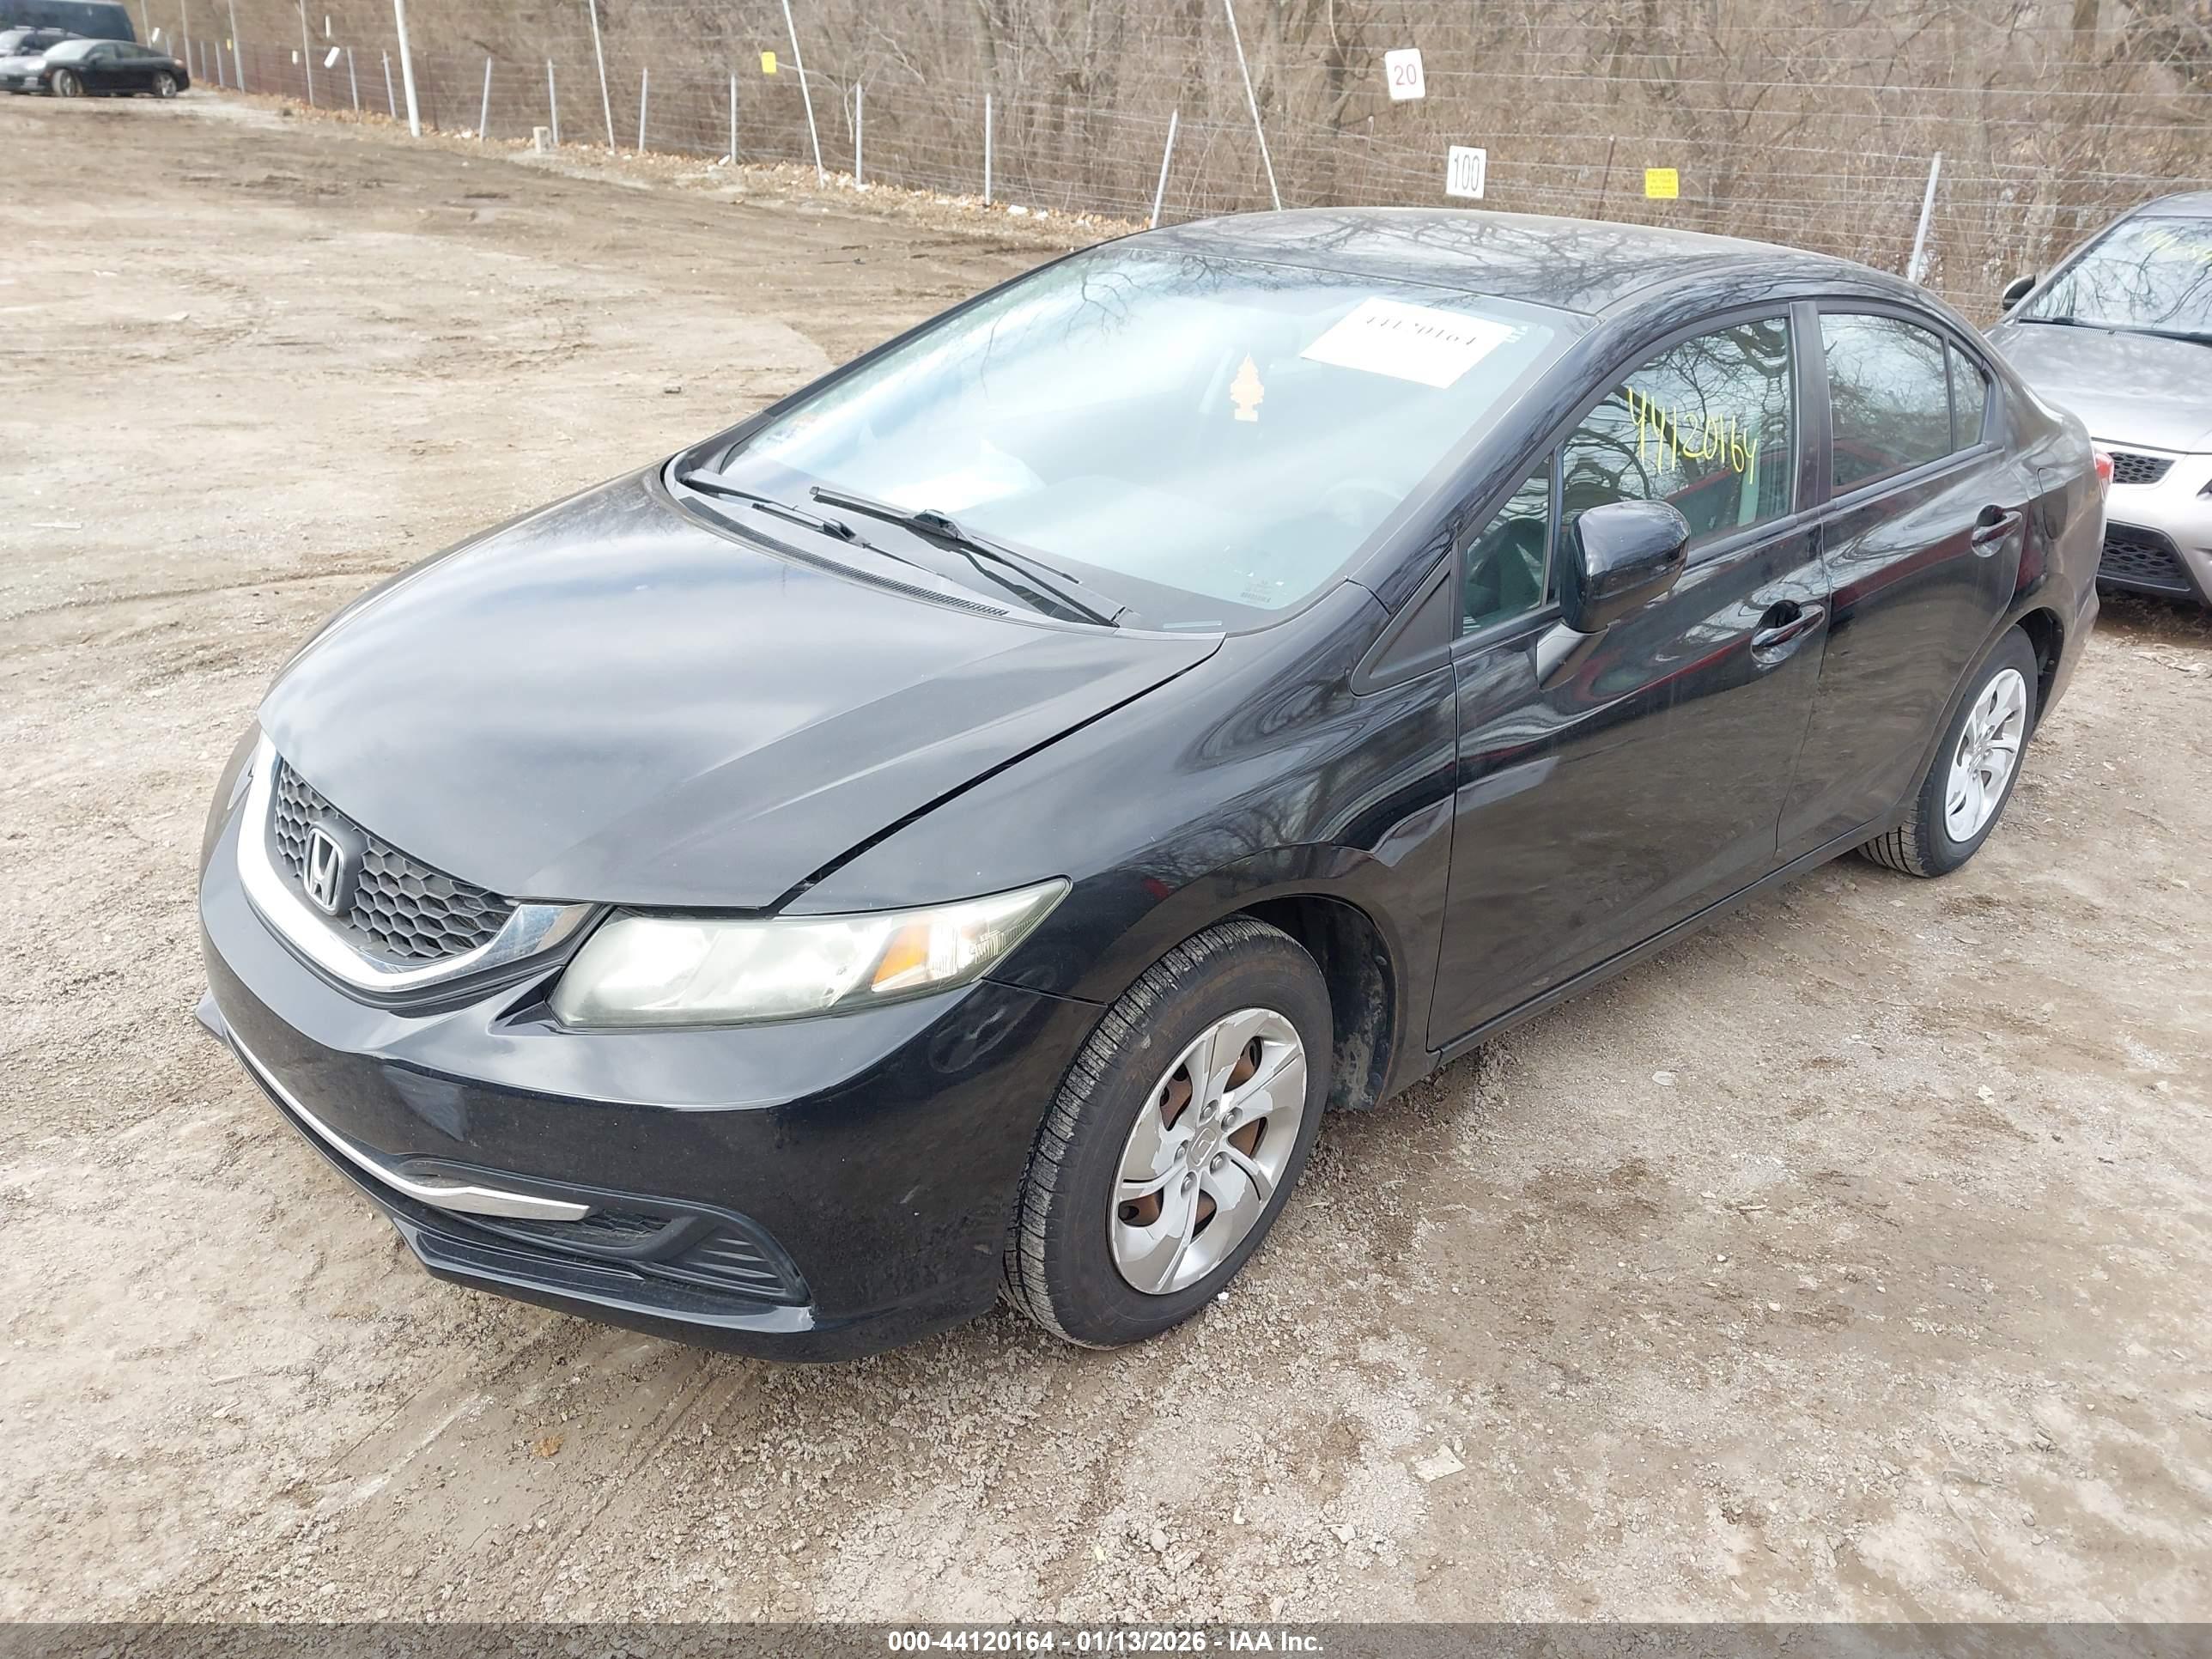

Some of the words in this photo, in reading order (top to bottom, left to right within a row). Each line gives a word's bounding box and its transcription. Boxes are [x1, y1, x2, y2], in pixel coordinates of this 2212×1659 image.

[1393, 63, 1418, 86] 20
[1453, 153, 1481, 191] 100
[1628, 385, 1758, 485] 44120164
